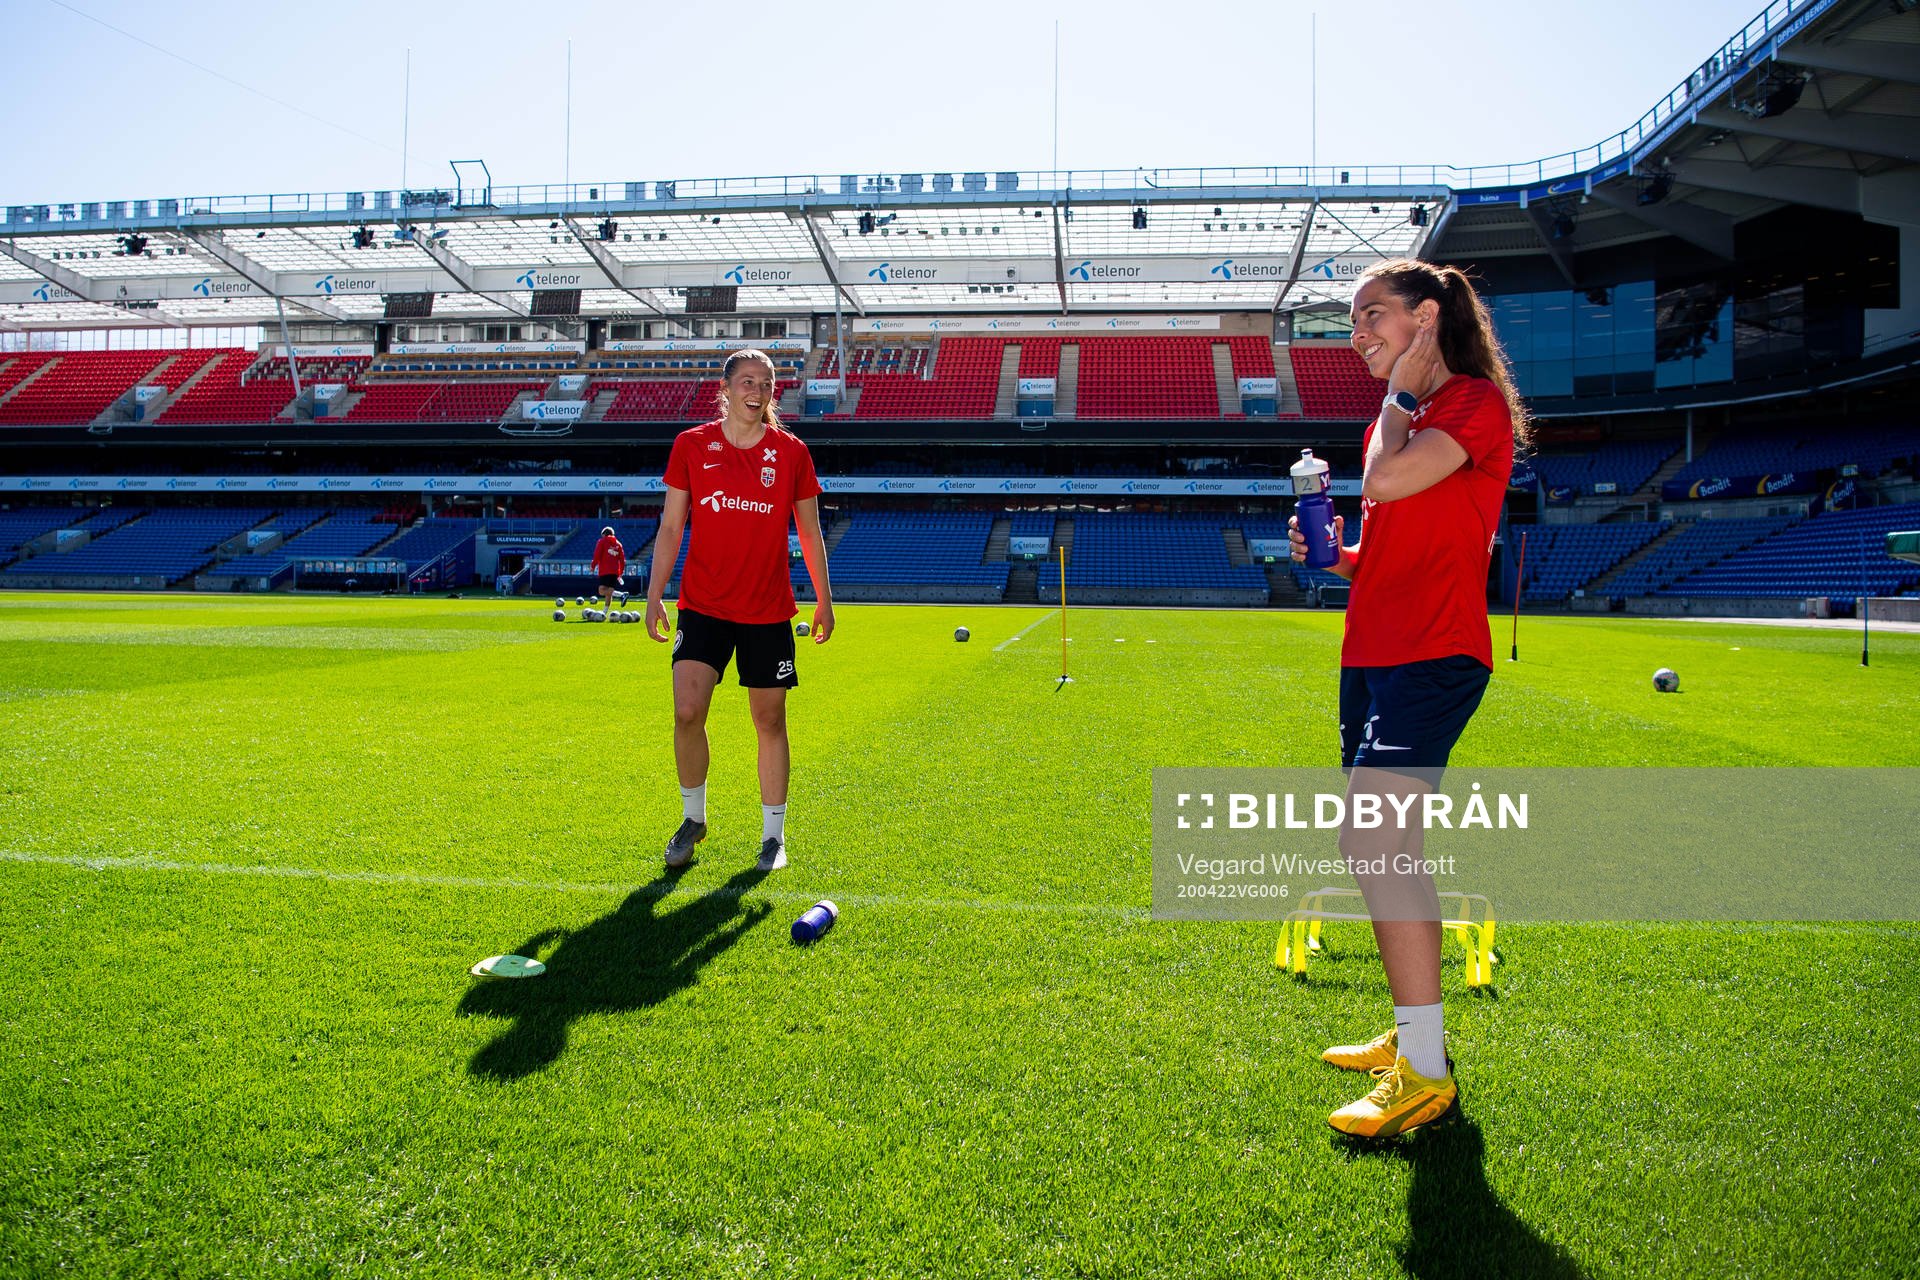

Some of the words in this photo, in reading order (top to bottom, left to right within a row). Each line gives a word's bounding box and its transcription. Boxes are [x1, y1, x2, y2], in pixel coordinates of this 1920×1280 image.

[746, 268, 792, 280] telenor
[890, 266, 937, 279] telenor
[1092, 264, 1141, 277] telenor
[1234, 262, 1284, 276] telenor
[536, 272, 580, 284] telenor
[211, 281, 251, 293] telenor
[334, 279, 376, 290] telenor
[939, 320, 962, 328] telenor
[1057, 319, 1080, 327] telenor
[1177, 318, 1200, 326] telenor
[544, 406, 580, 416] telenor
[1300, 478, 1312, 492] 2
[1701, 478, 1731, 496] Bendit
[1767, 472, 1794, 493] Bendit
[722, 495, 774, 514] telenor
[778, 660, 793, 672] 25
